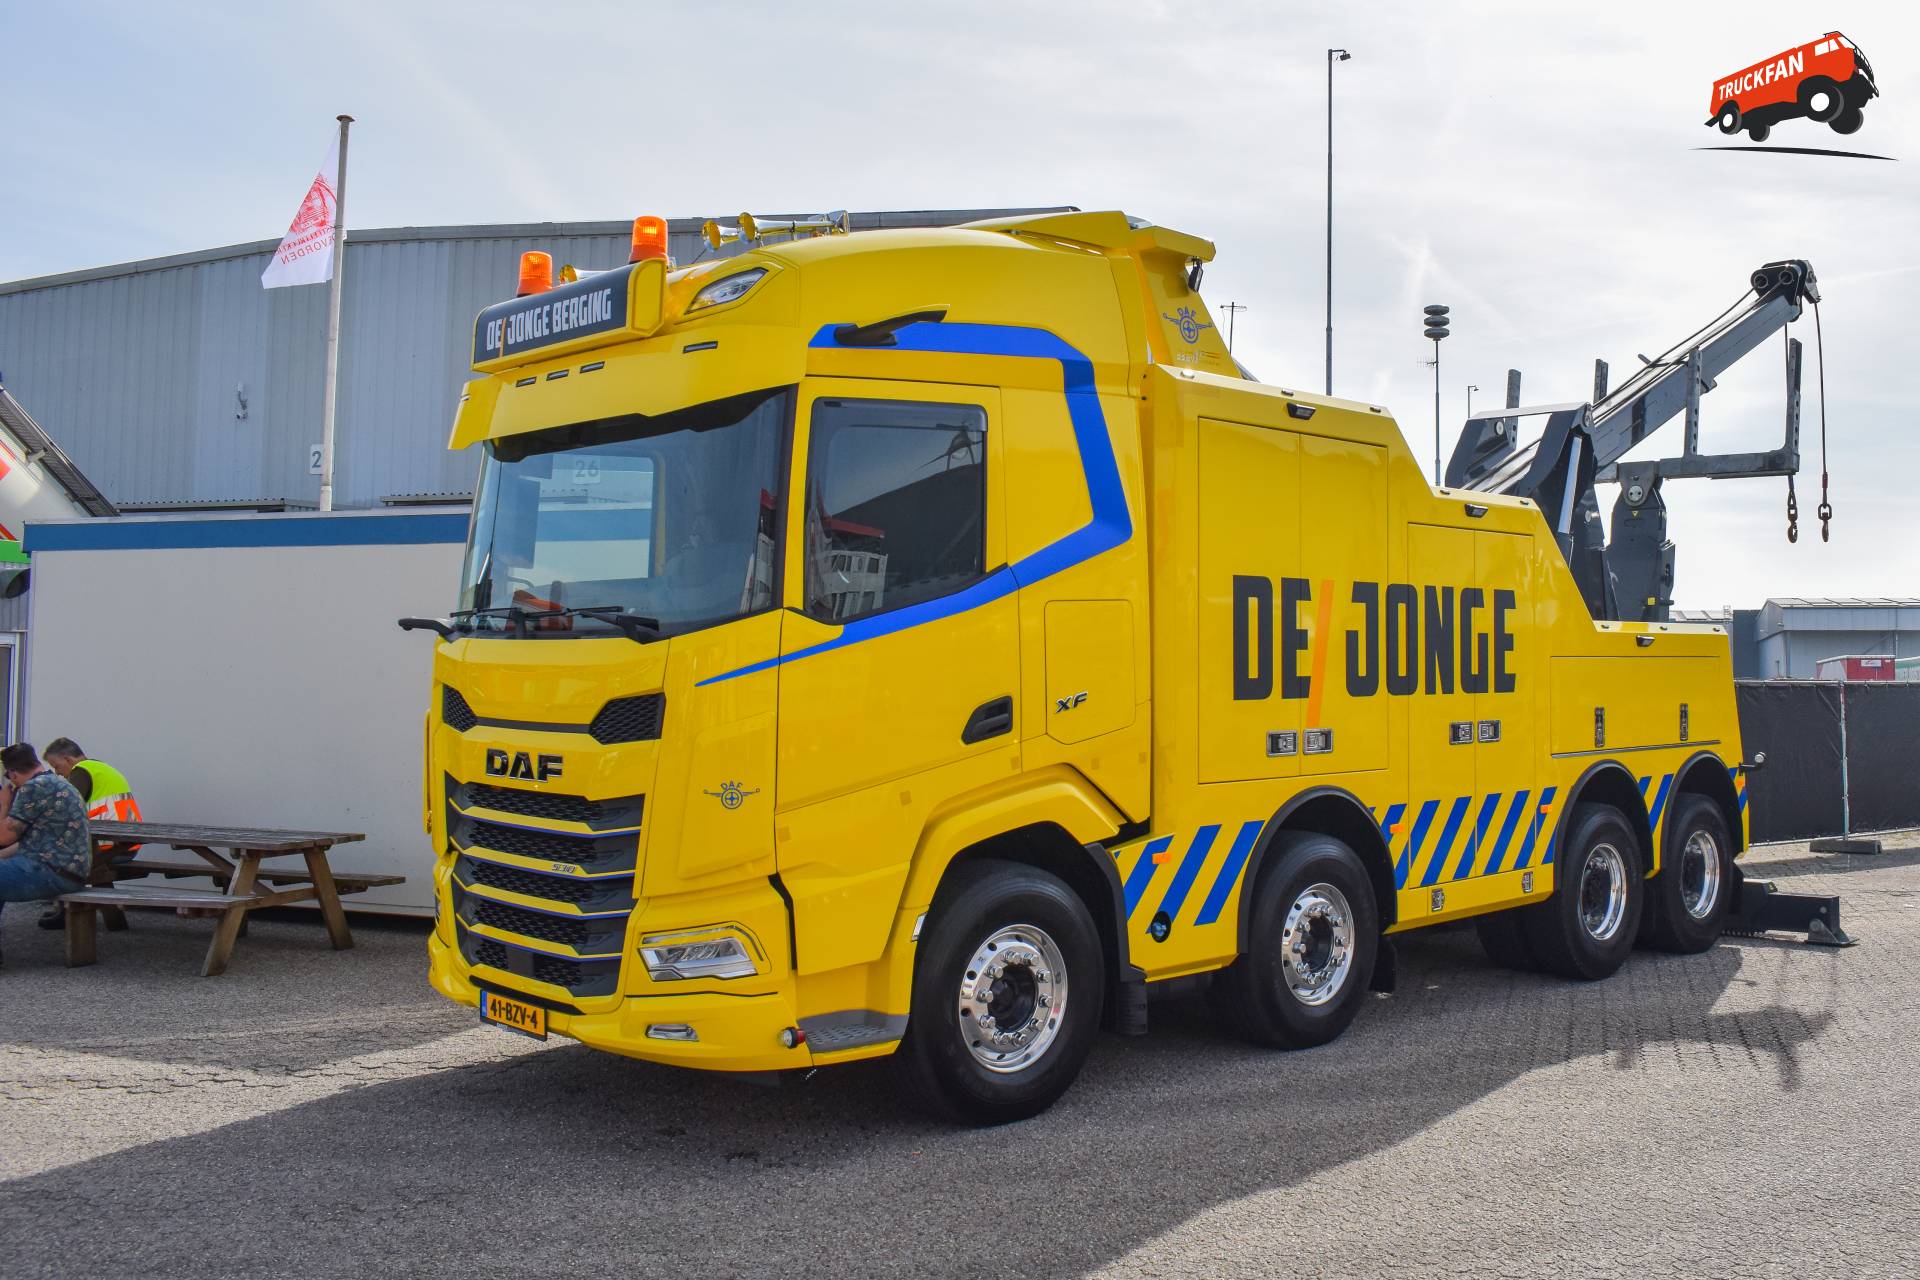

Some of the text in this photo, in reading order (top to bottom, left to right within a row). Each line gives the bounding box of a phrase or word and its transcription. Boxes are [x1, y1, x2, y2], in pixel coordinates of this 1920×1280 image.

[486, 288, 611, 351] DE JONGE BERGING
[312, 451, 322, 468] 2
[1233, 575, 1516, 700] DE JONGE
[1056, 691, 1088, 713] XF
[486, 748, 563, 783] DAF
[490, 998, 538, 1030] 41-BZV-4
